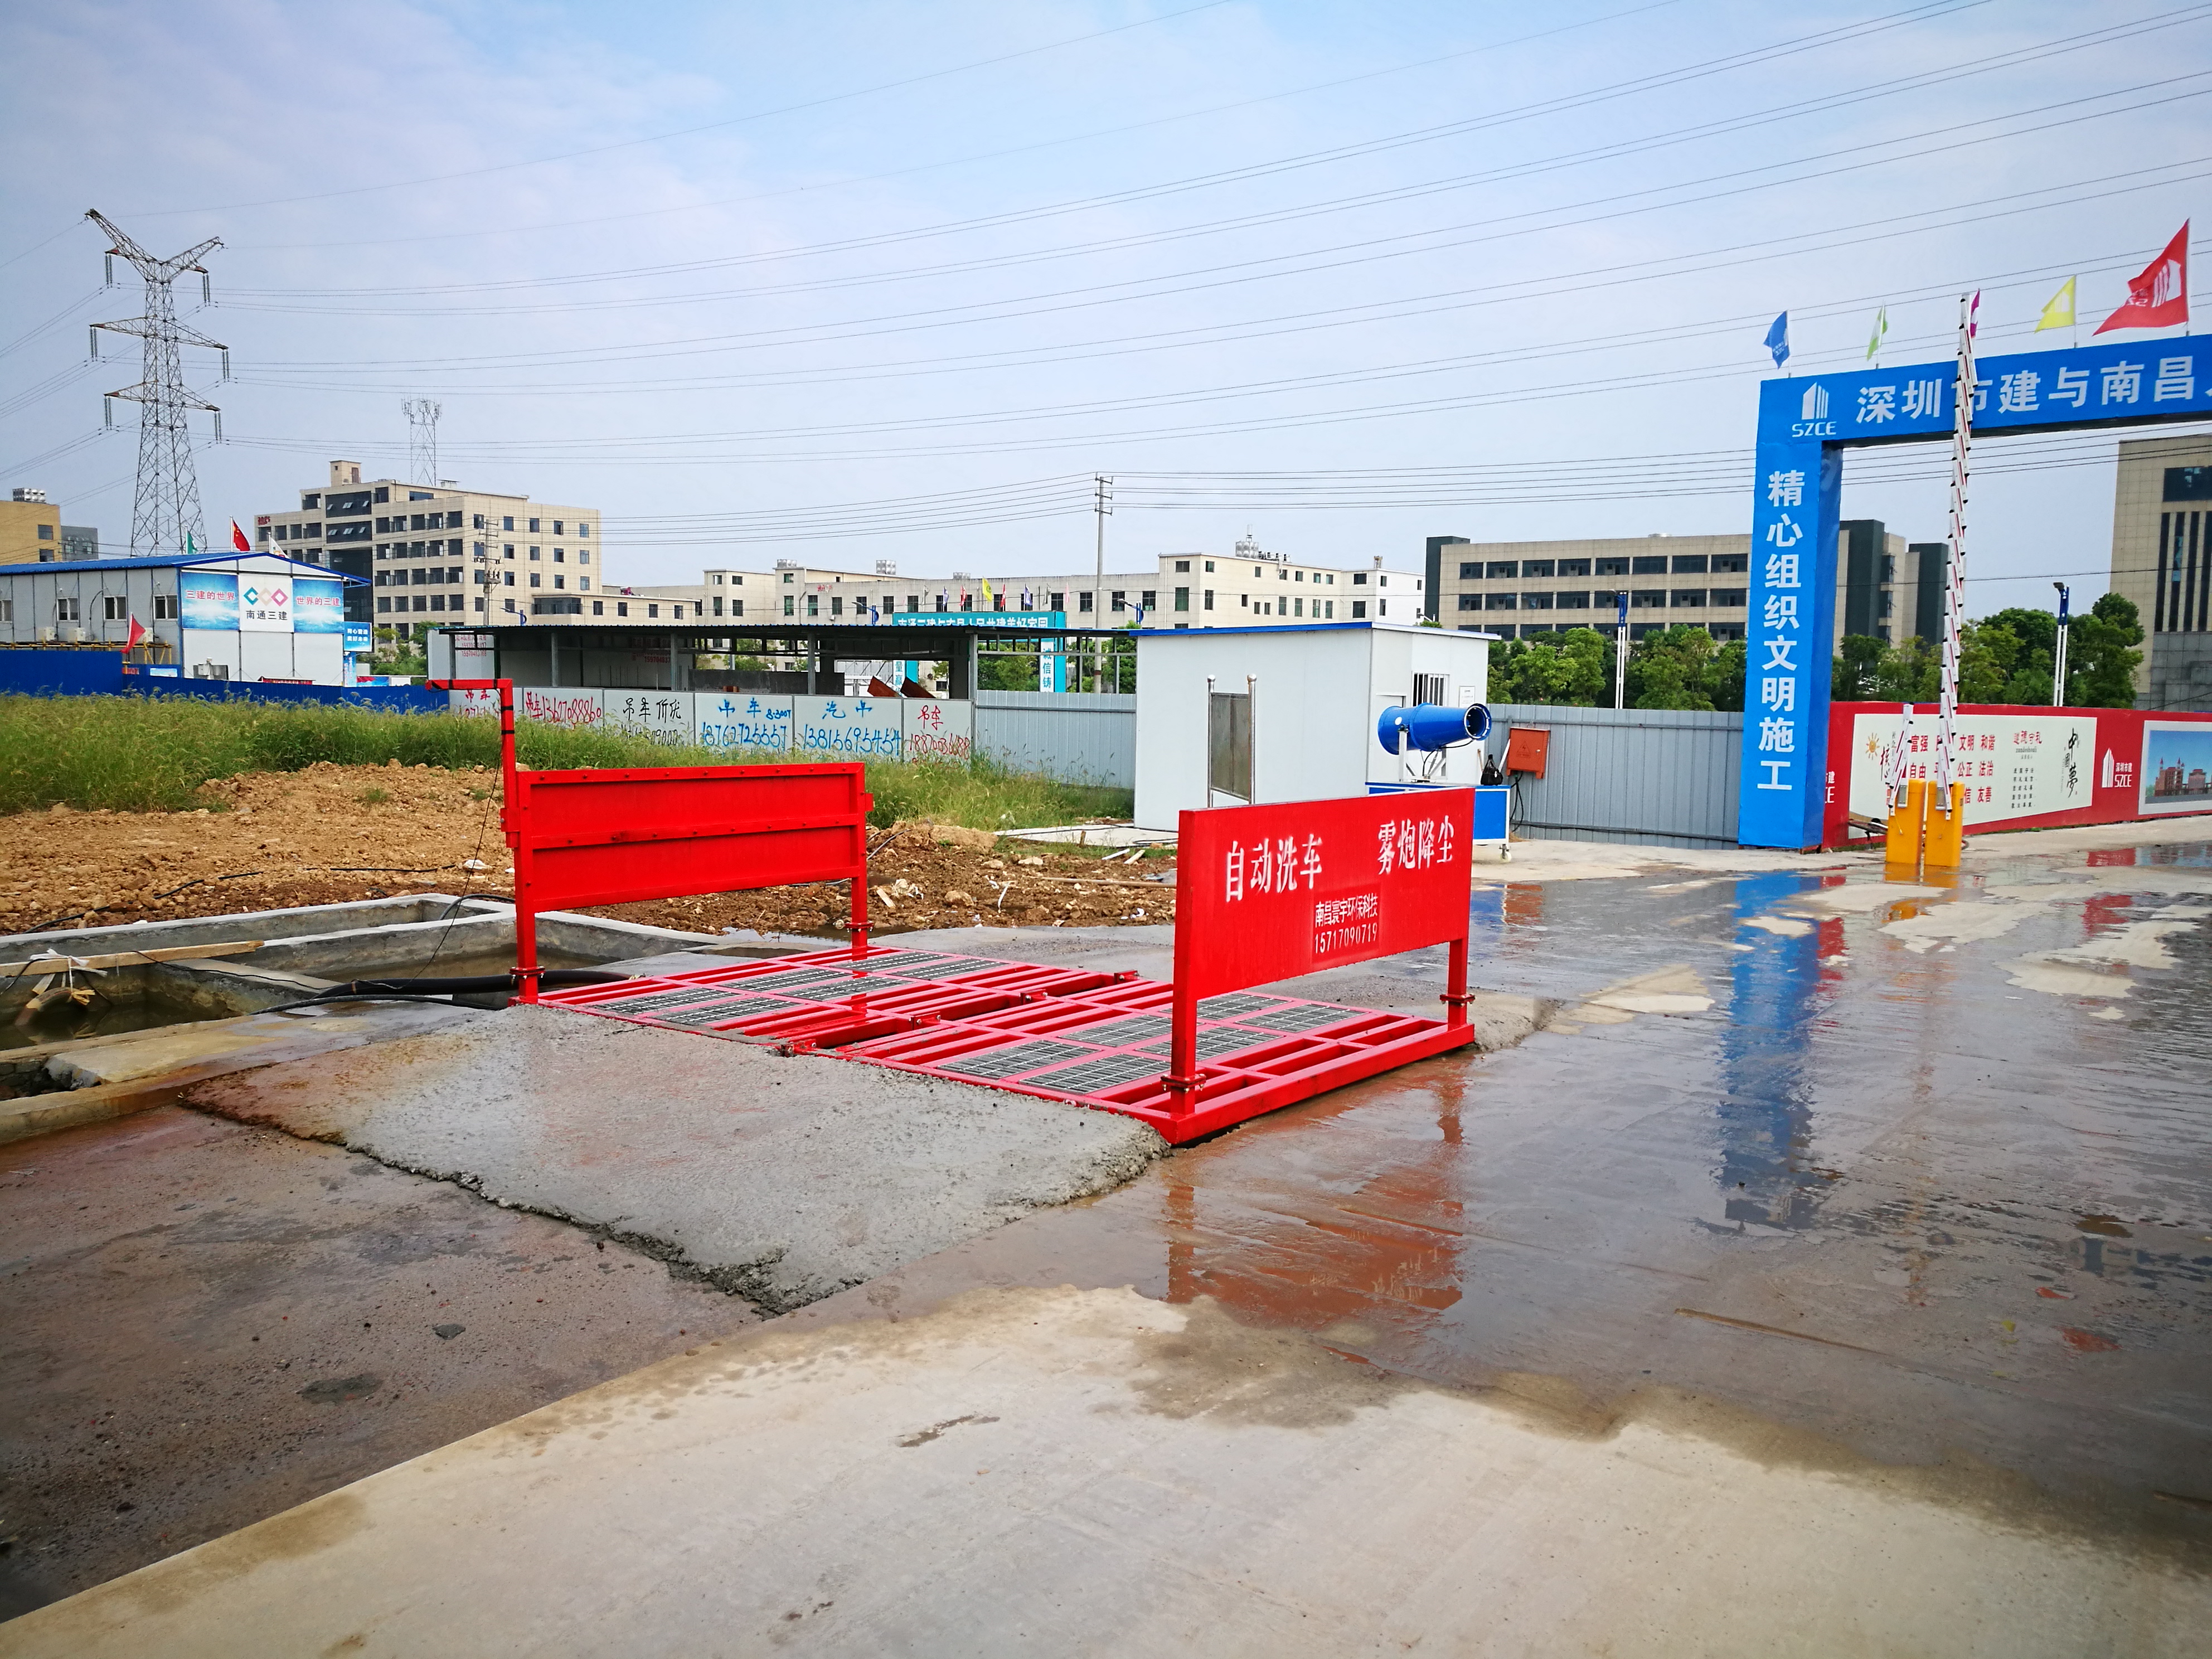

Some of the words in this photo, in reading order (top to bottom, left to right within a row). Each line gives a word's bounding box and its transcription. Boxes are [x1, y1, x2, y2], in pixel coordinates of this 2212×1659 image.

[1856, 356, 2212, 424] 深圳市建与南昌
[1792, 421, 1837, 438] SZCE
[186, 590, 236, 601] 三建的世界
[296, 596, 341, 607] 世界的三建
[246, 610, 288, 620] 南通三建
[1758, 470, 1805, 790] 精心组织文明施工
[803, 724, 901, 756] 13815695454
[1911, 734, 1928, 753] 富强
[1959, 734, 1975, 751] 文明
[1980, 734, 1996, 751] 和谐
[1910, 762, 1926, 779] 自由
[1957, 761, 1973, 777] 公正
[1979, 760, 1993, 777] 法治
[2114, 774, 2132, 788] SZCE
[1977, 786, 1992, 803] 友善
[1226, 833, 1323, 903] 自动洗车
[1377, 815, 1454, 875] 雾炮降尘
[1315, 893, 1378, 928] 南昌寰宇环保科技
[1315, 923, 1377, 954] 15717090719
